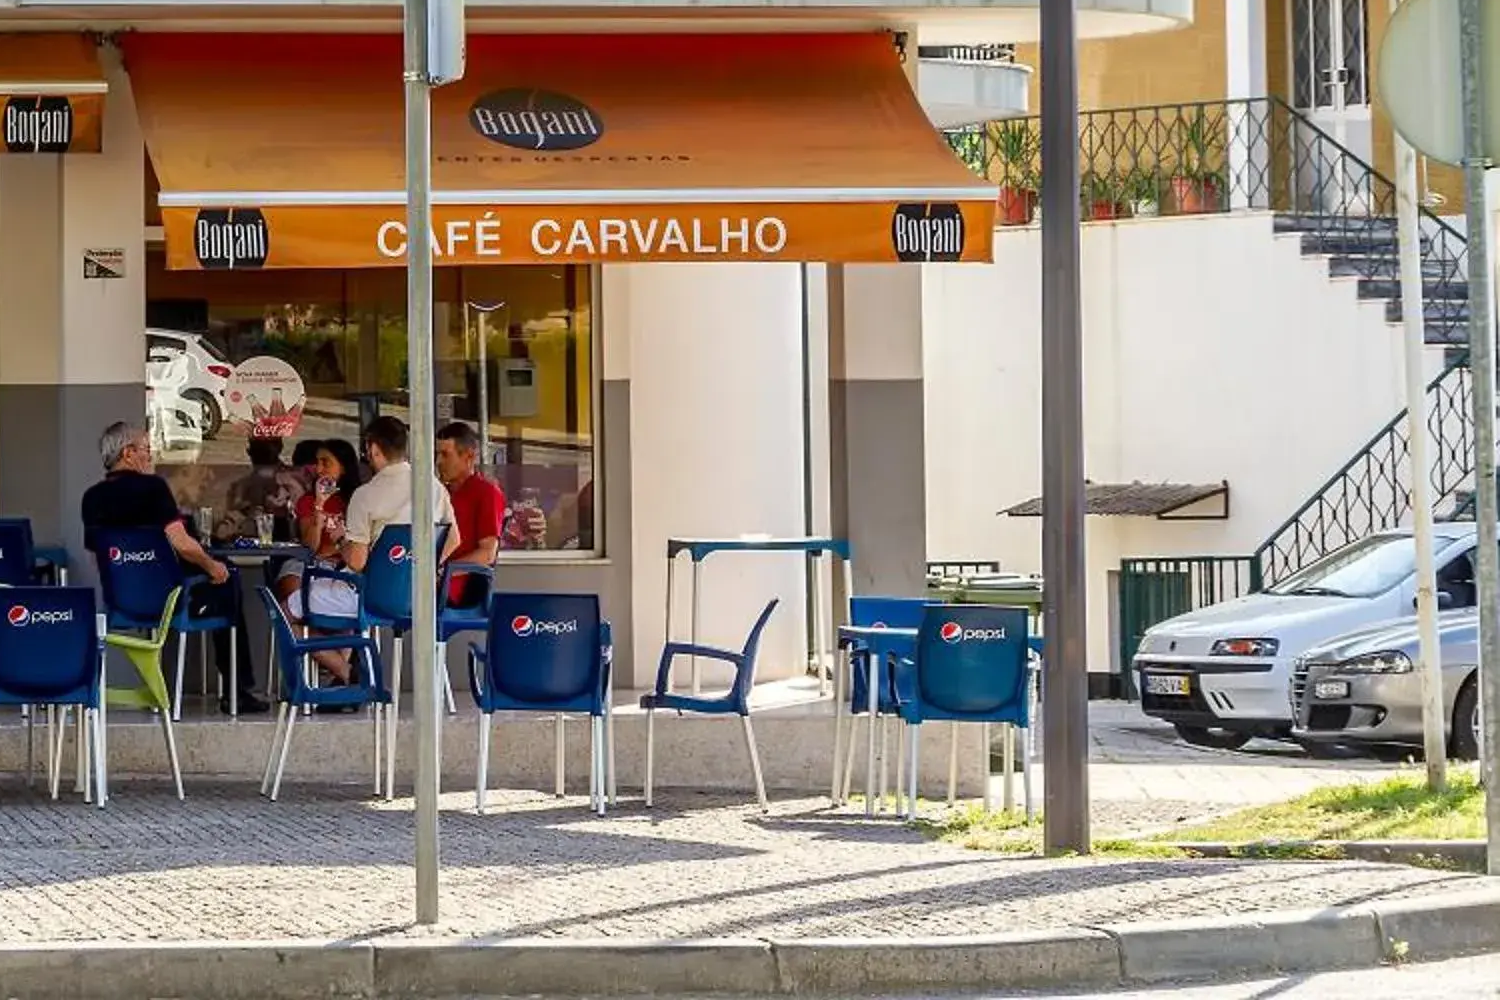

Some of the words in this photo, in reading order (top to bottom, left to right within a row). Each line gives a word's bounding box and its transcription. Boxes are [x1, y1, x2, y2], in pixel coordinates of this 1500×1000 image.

[6, 105, 69, 153] Bogani
[474, 107, 598, 149] Bogani
[197, 218, 265, 269] Bogani
[530, 216, 788, 256] CARVALHO
[895, 212, 962, 262] Bogani
[122, 547, 156, 564] pepsi
[31, 607, 73, 624] pepsi
[534, 618, 579, 634] pepsi
[962, 626, 1006, 642] pepsi
